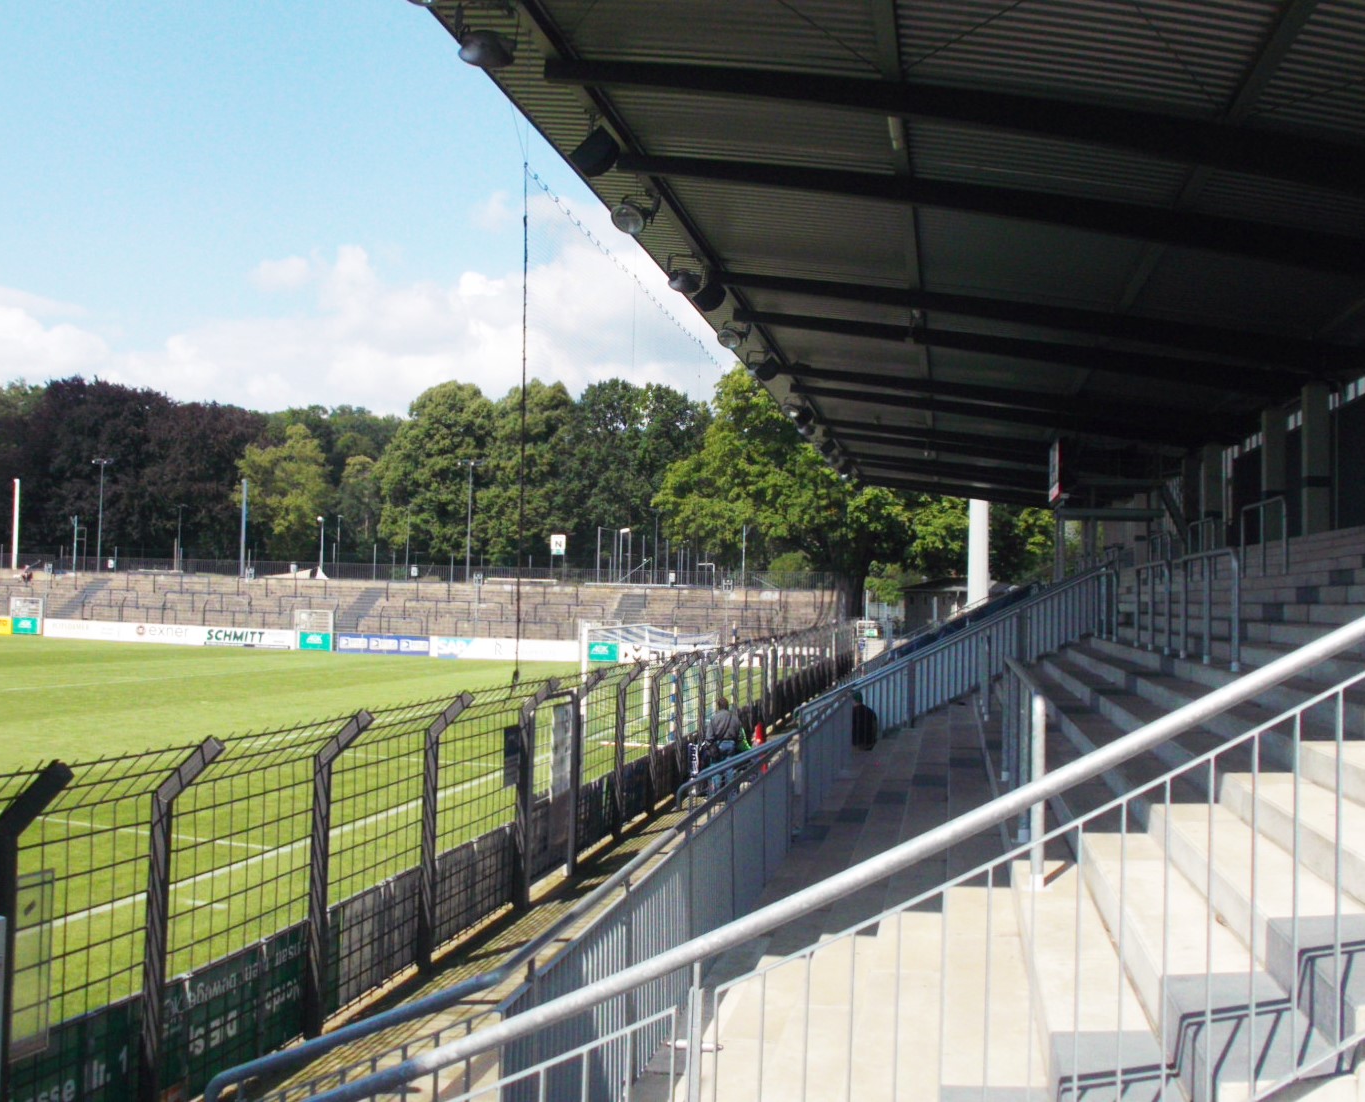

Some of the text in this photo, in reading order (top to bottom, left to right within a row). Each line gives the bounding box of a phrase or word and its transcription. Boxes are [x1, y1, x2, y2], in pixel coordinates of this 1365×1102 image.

[148, 626, 189, 638] exner
[206, 629, 266, 643] SCHMITT
[437, 639, 466, 655] SAP
